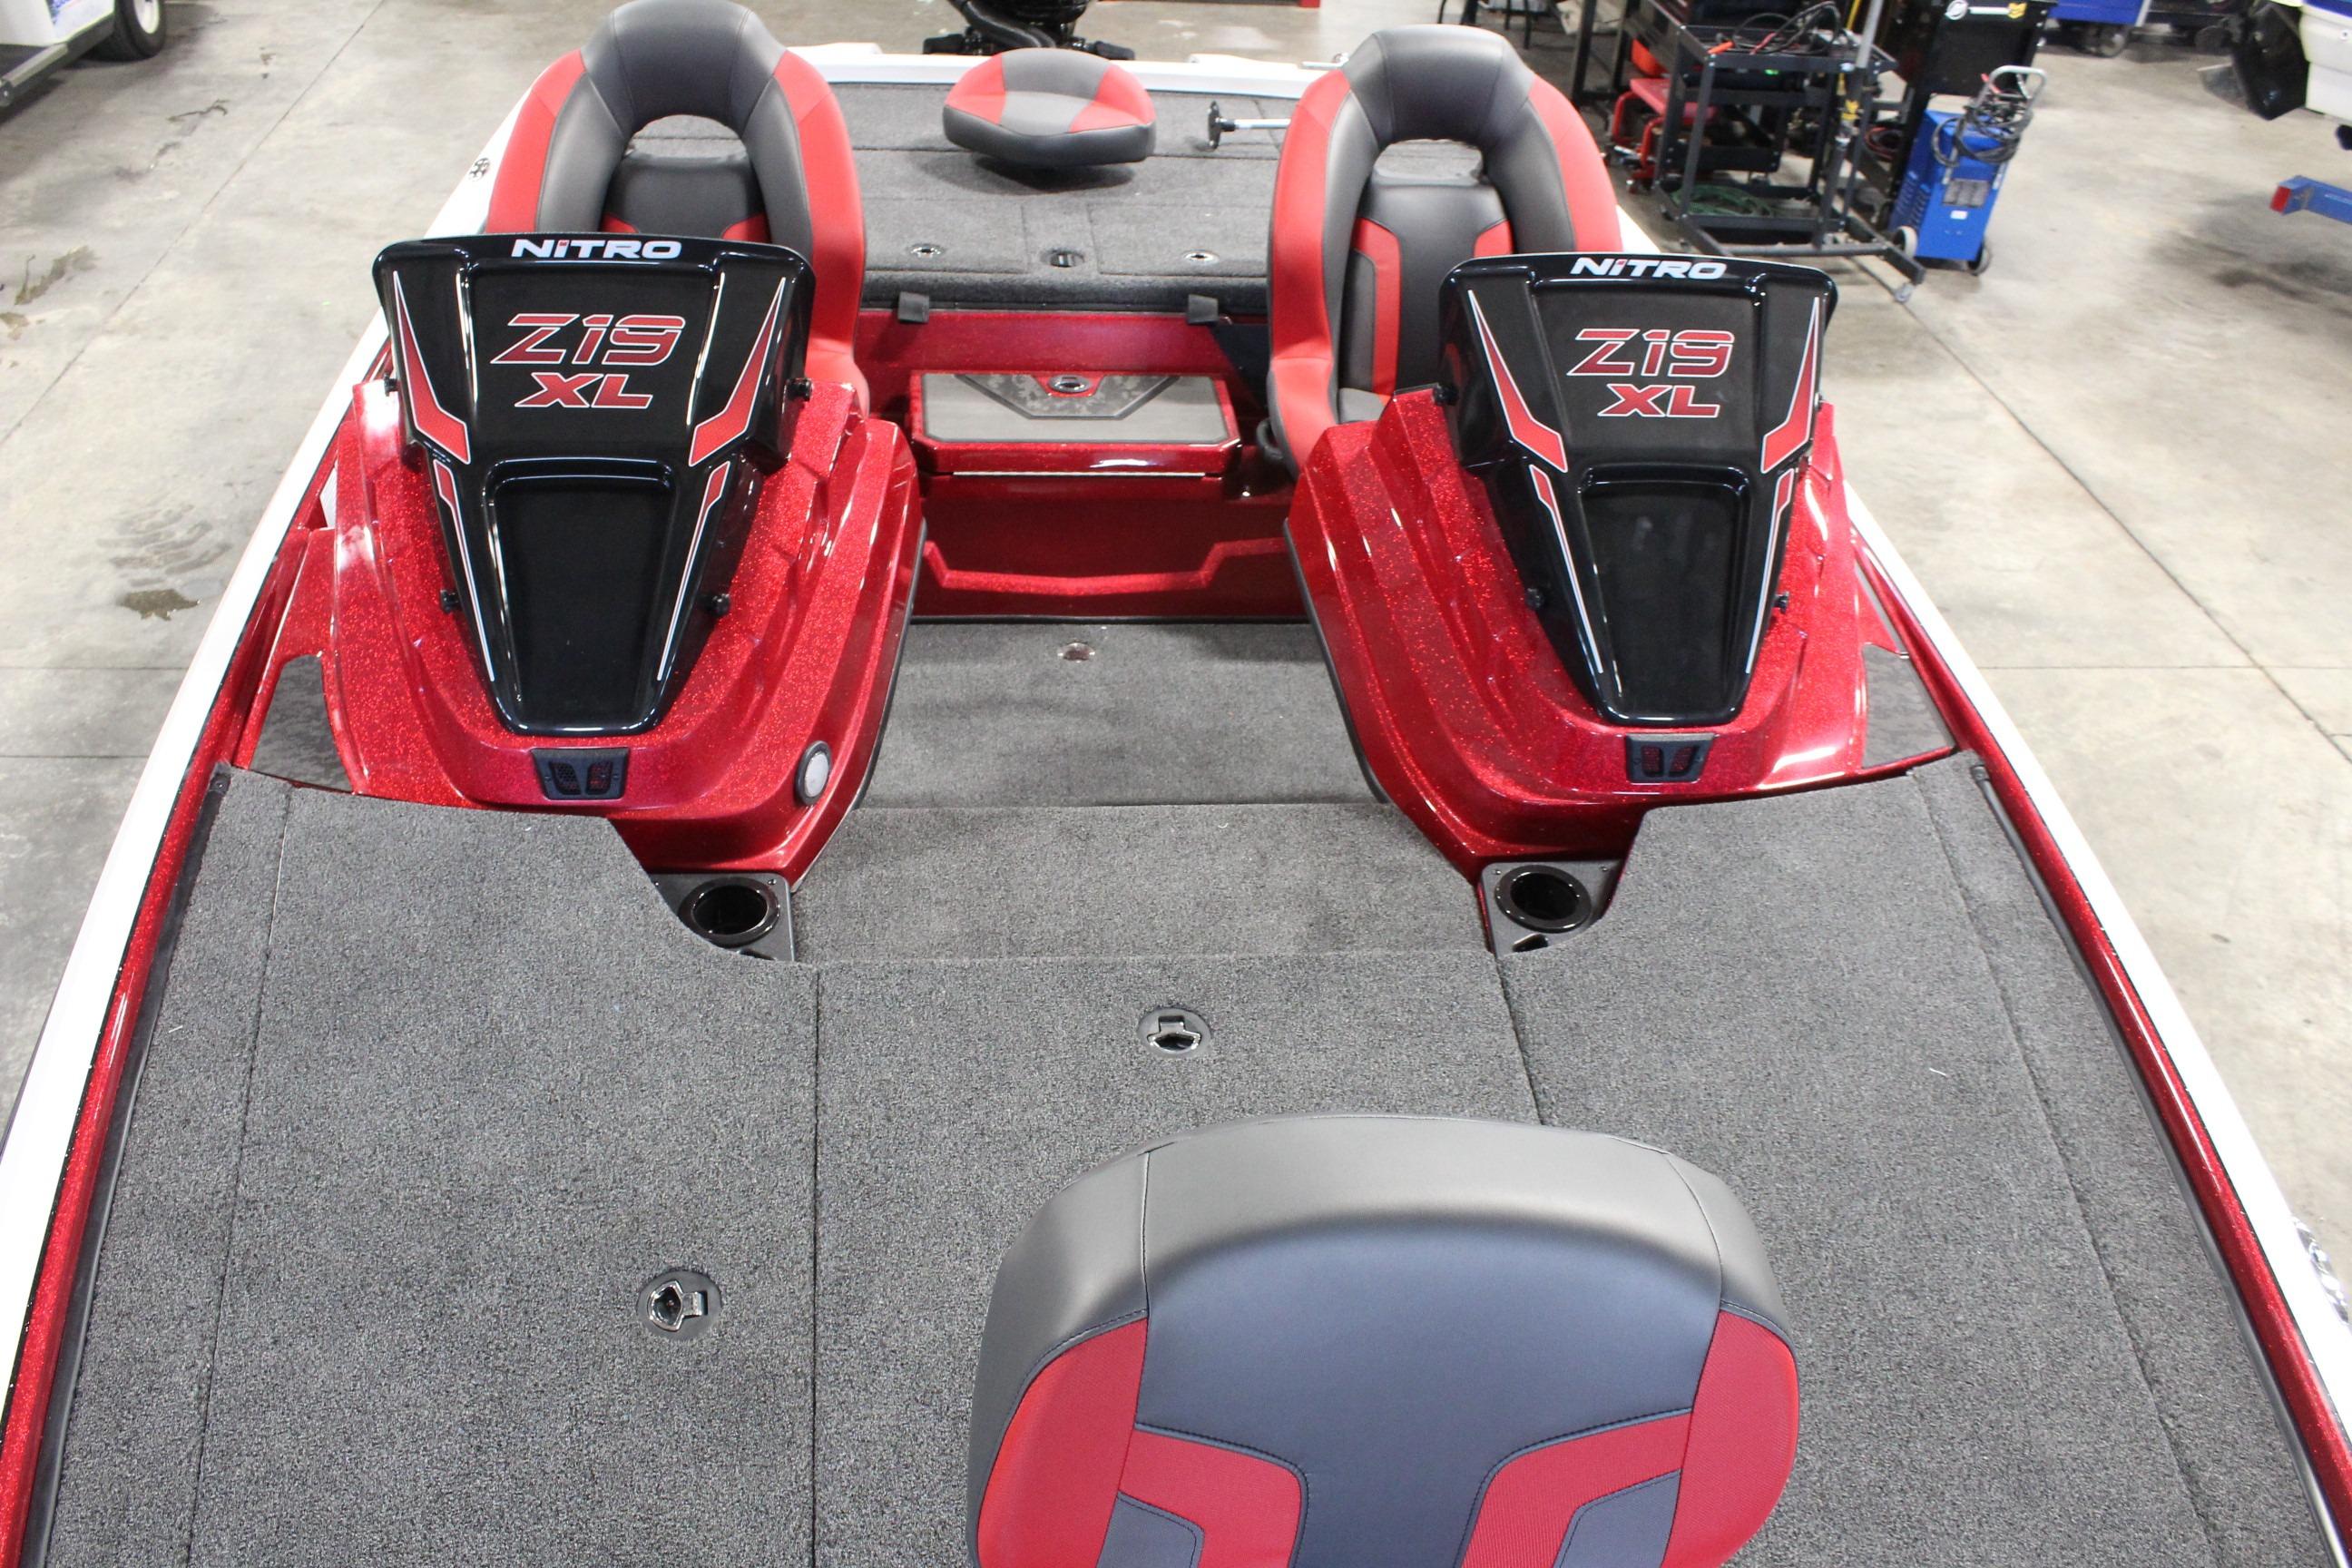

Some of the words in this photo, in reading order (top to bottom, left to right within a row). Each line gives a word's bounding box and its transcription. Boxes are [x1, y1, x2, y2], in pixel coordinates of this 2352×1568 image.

[490, 313, 687, 366] Z19
[1566, 328, 1735, 377] Z19
[514, 372, 653, 408] XL
[1597, 383, 1721, 418] XL
